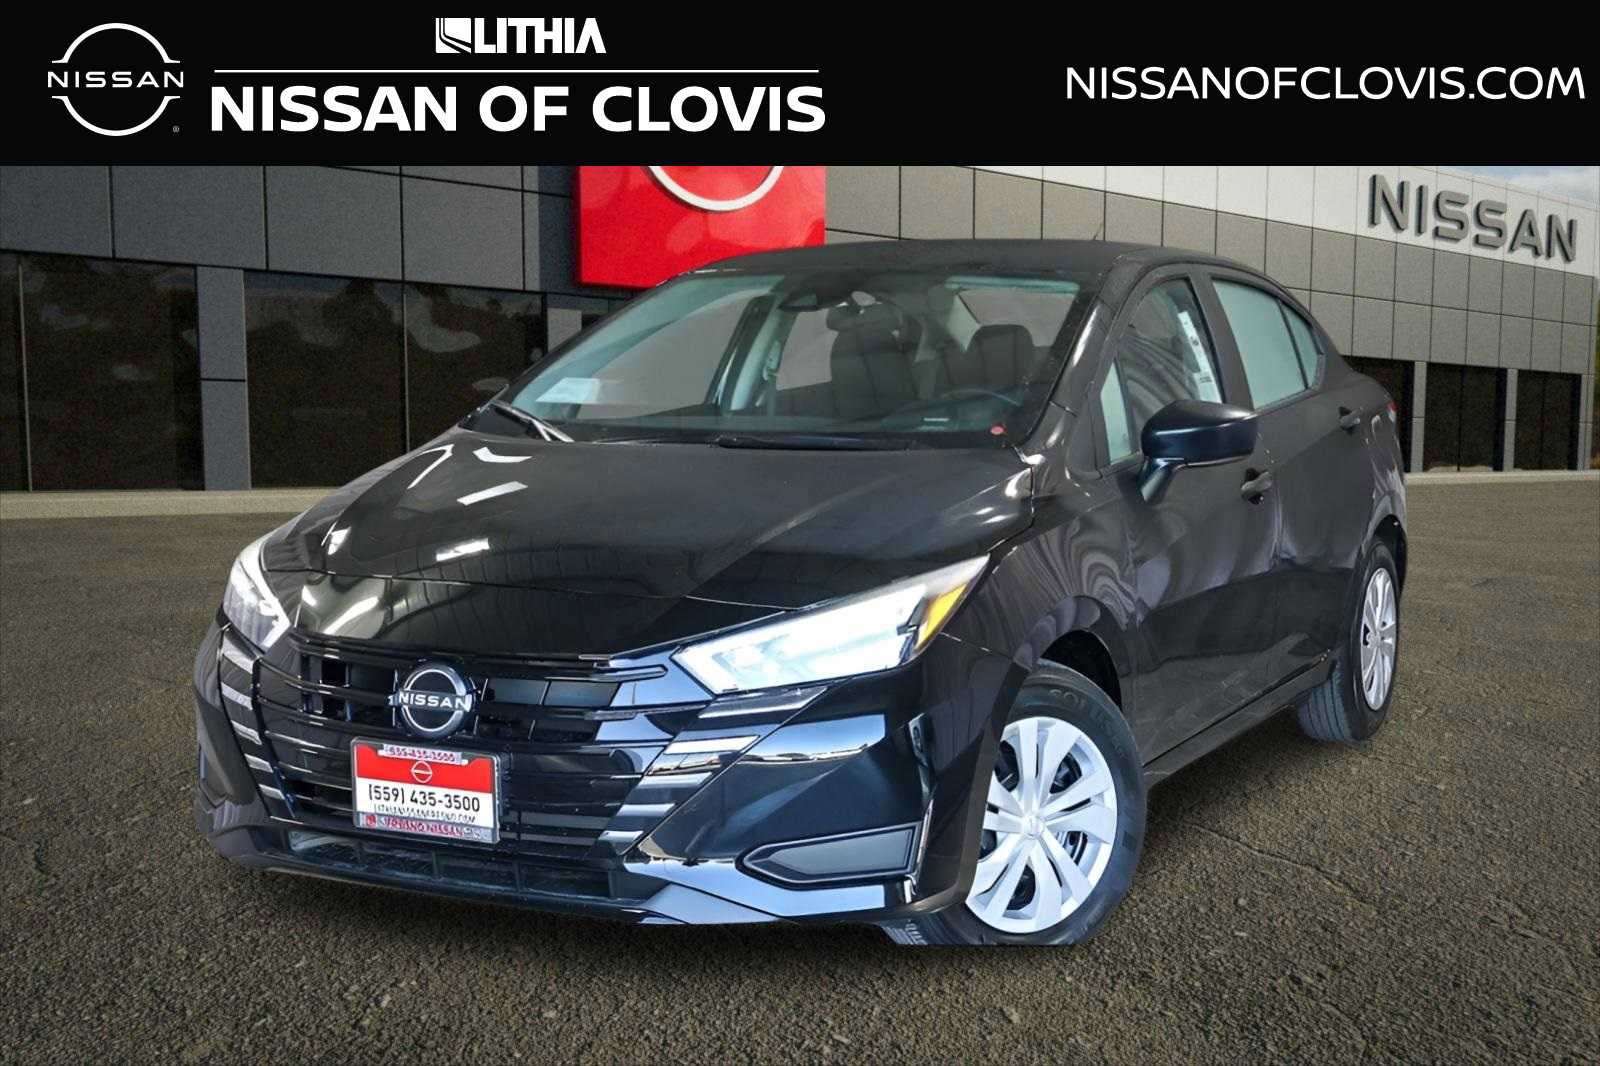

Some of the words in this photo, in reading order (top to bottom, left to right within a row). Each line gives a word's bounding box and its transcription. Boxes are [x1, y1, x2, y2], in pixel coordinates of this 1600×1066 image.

[1368, 174, 1578, 263] NISSAN
[399, 691, 472, 712] NISSAN
[368, 783, 405, 804] (559)
[409, 789, 481, 812] 435-3500
